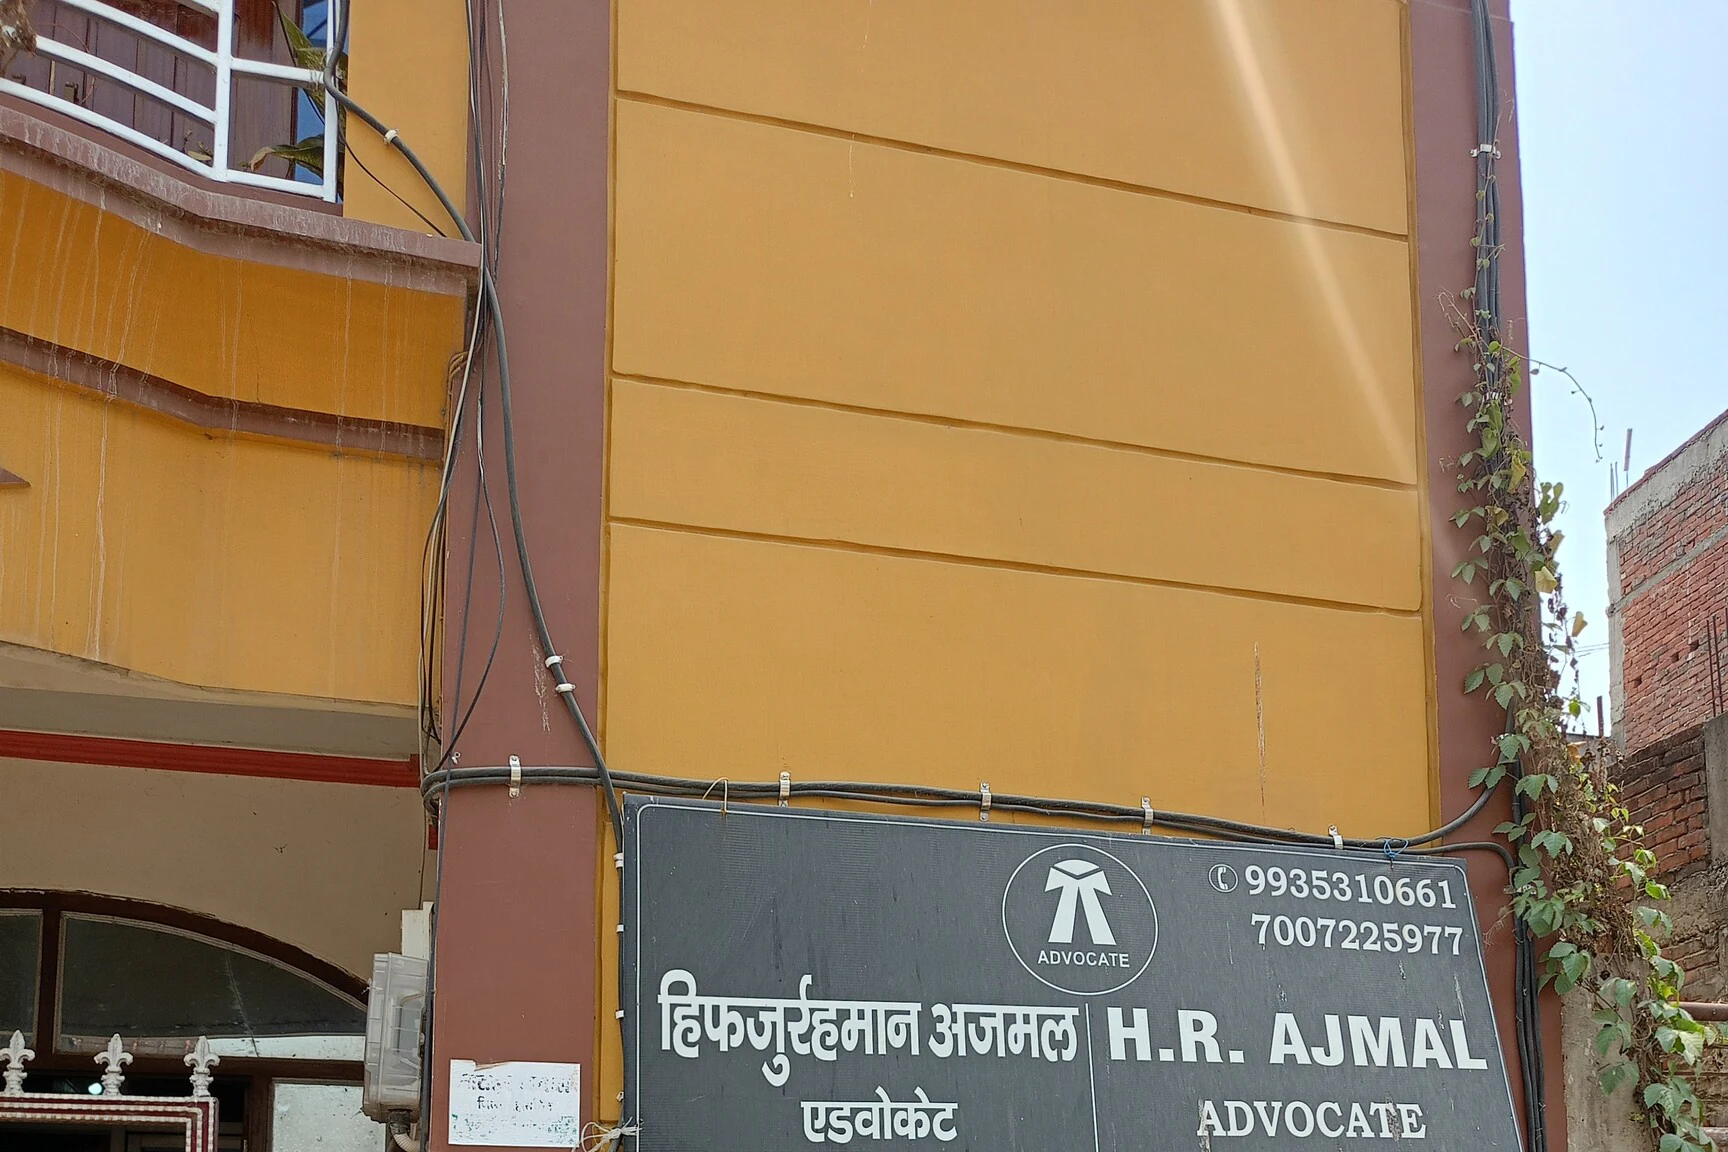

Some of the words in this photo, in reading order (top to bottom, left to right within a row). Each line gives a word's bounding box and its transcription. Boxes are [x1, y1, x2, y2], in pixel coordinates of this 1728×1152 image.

[1245, 864, 1457, 909] 9935310661
[1250, 913, 1463, 956] 7007225977
[1037, 950, 1130, 968] ADVOCATE
[928, 1003, 1080, 1062] अजमल
[1106, 1006, 1245, 1064] H.R.
[1269, 1012, 1489, 1070] AJMAL
[800, 1085, 959, 1143] एडवोकेट
[1196, 1100, 1427, 1139] ADVOCATE
